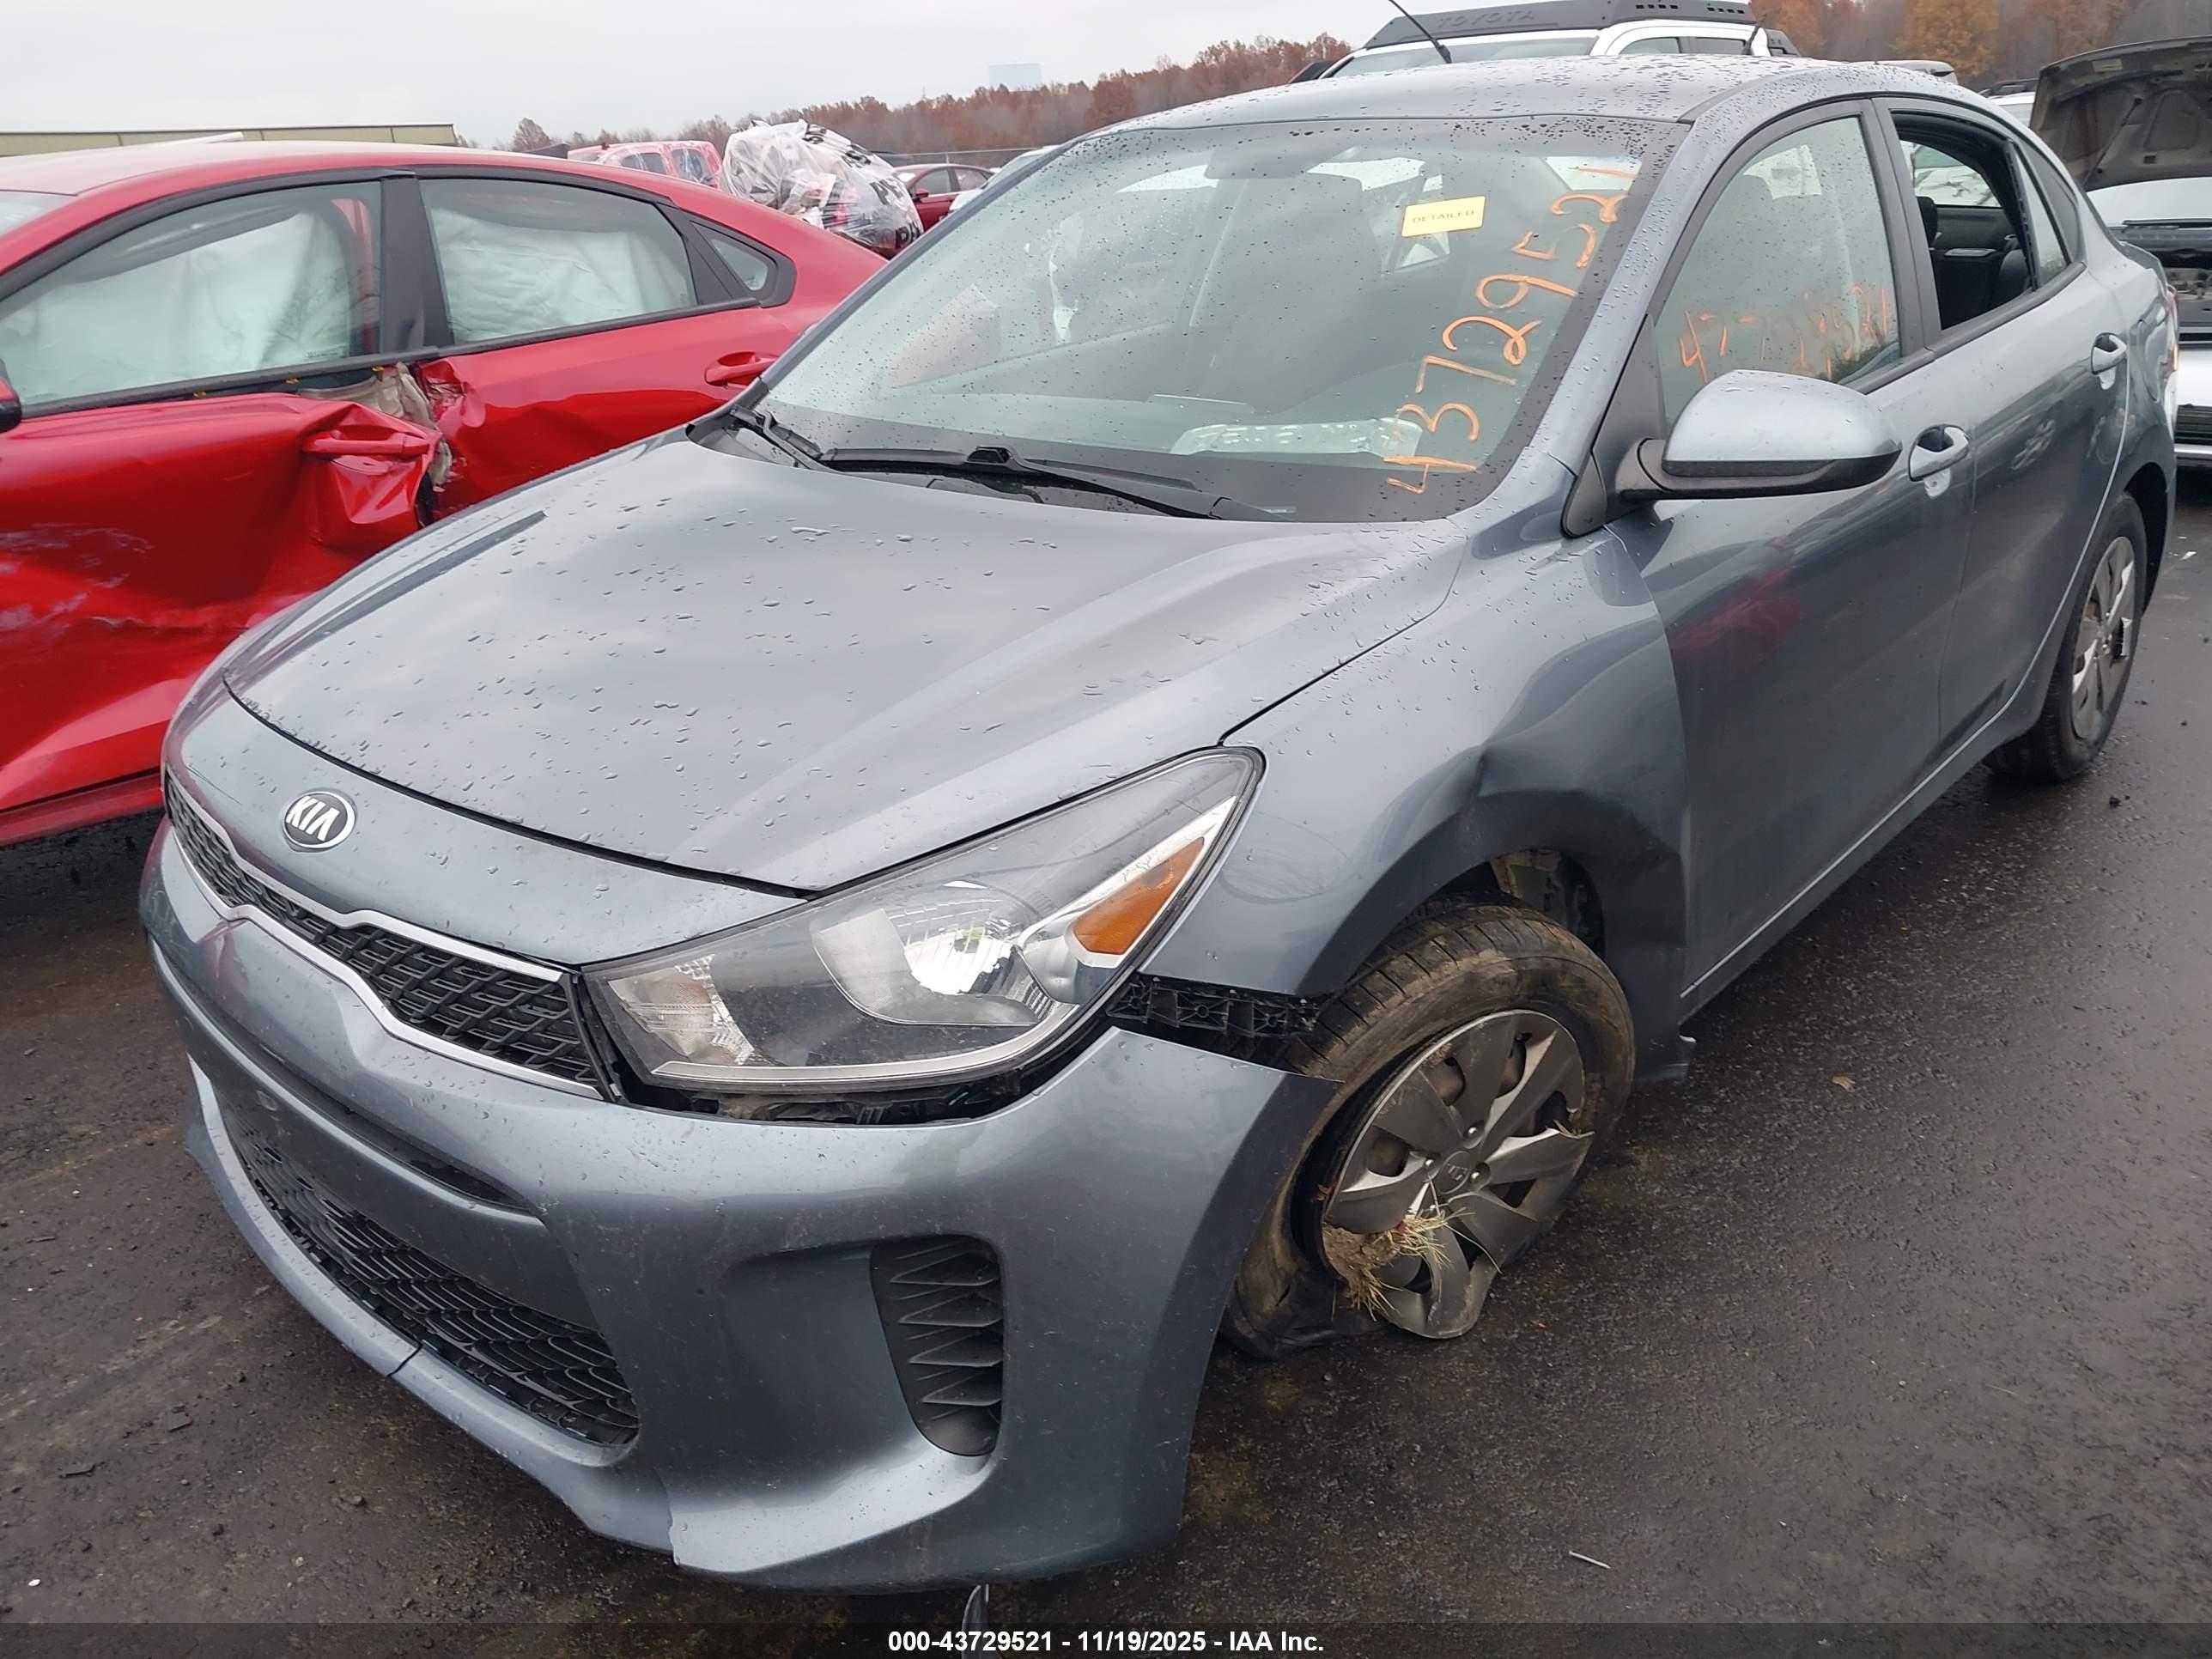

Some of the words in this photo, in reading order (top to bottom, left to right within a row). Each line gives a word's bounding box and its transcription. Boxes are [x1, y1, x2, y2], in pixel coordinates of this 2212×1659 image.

[1412, 209, 1474, 223] DETAILED
[1382, 167, 1638, 495] 43729521
[285, 795, 340, 842] KIA
